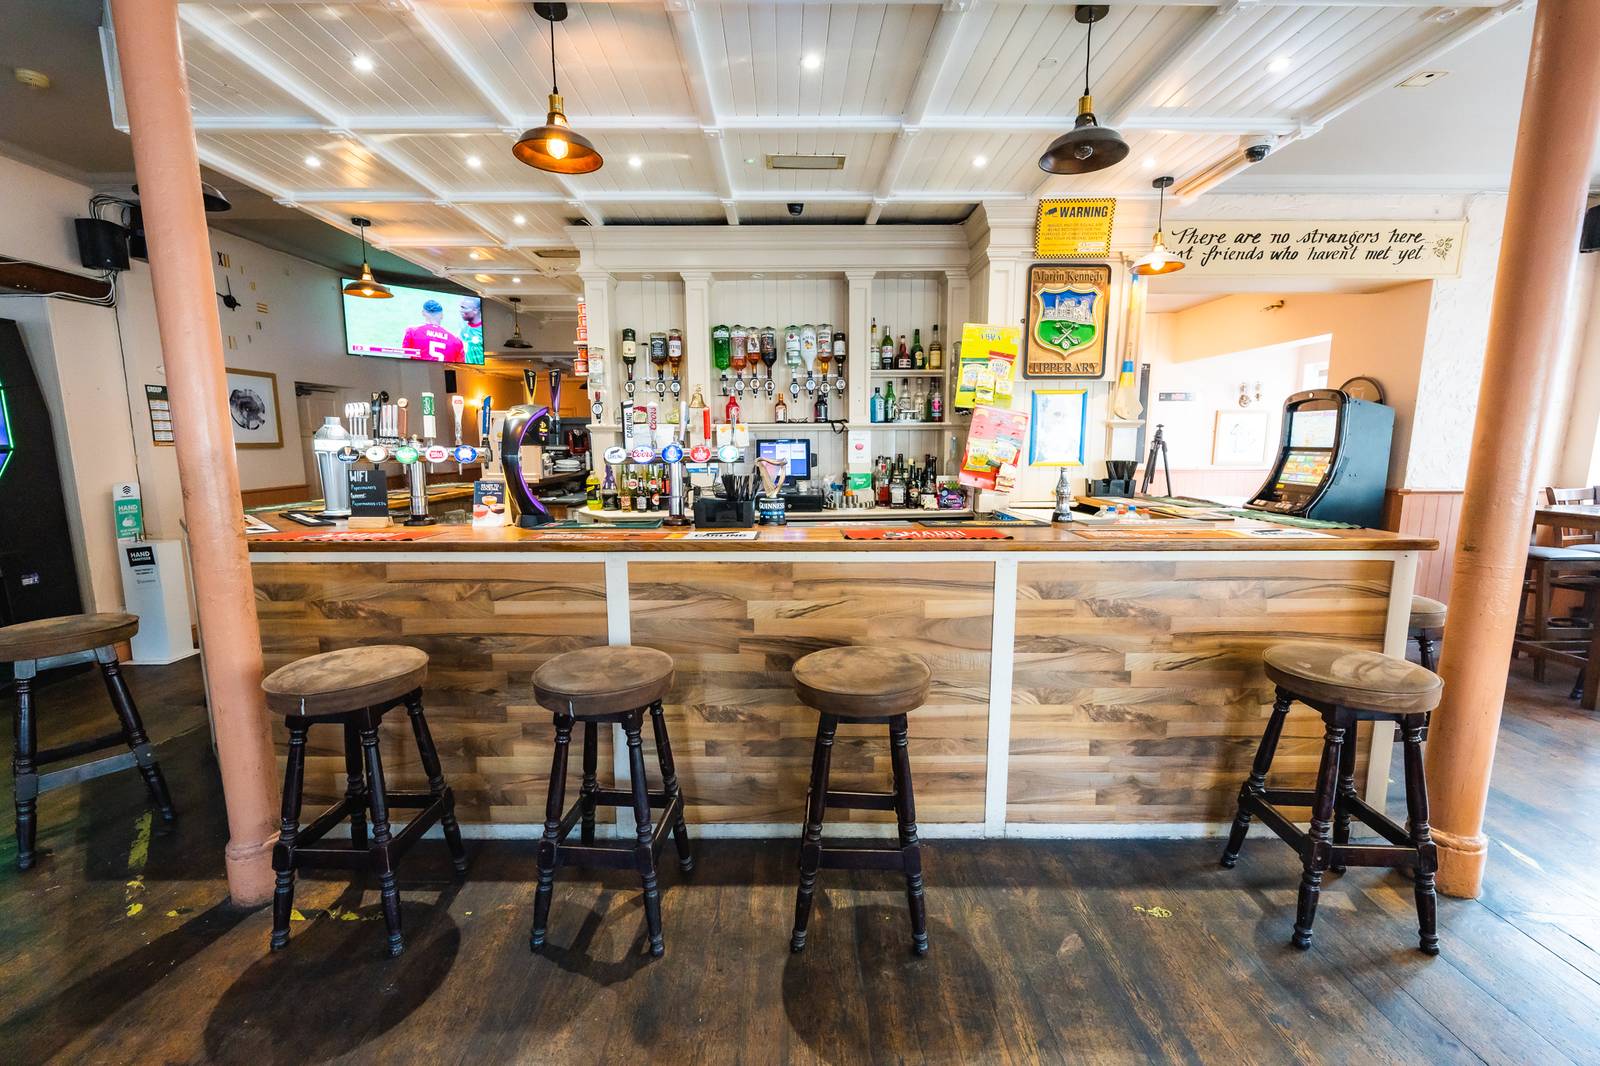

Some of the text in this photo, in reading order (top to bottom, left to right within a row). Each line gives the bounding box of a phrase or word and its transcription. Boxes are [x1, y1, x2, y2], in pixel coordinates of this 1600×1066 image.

[1059, 206, 1108, 218] WARNING
[1172, 227, 1226, 245] There
[1234, 232, 1262, 244] are
[1270, 232, 1290, 244] no
[1296, 228, 1380, 250] strangers
[1200, 245, 1264, 266] friends
[1270, 246, 1298, 260] who
[1365, 246, 1391, 260] met
[1392, 245, 1424, 265] yet
[1034, 270, 1104, 282] Martin Kennedy
[429, 340, 446, 361] 5
[1032, 362, 1098, 373] TIPPERARY
[631, 449, 653, 458] Coors
[349, 470, 368, 482] WIFI
